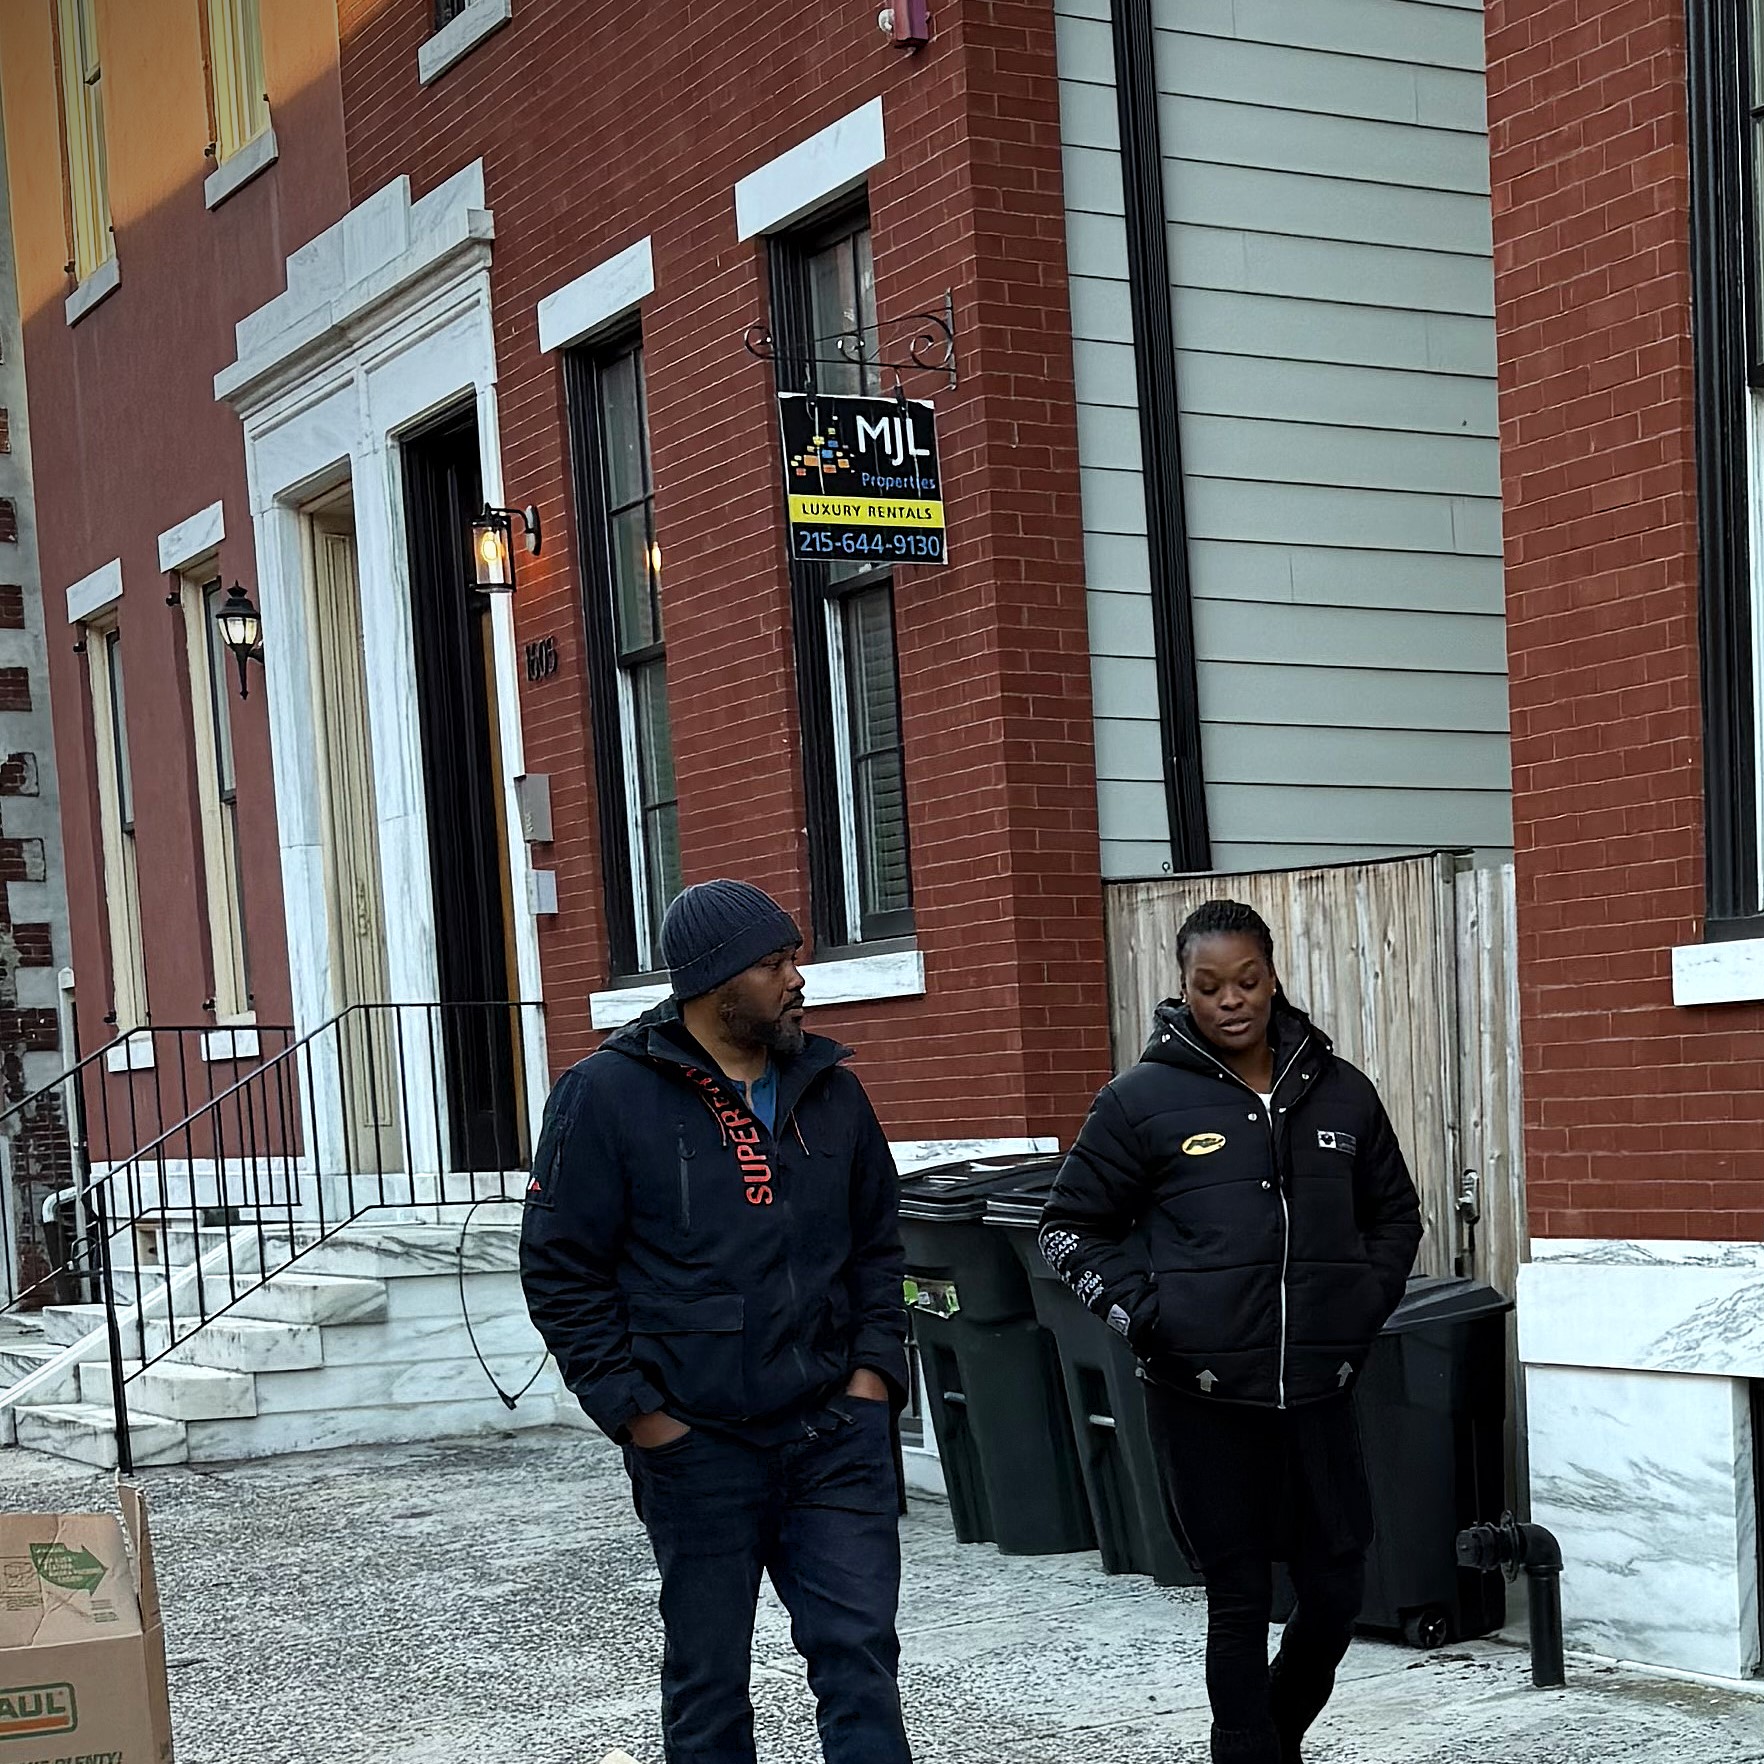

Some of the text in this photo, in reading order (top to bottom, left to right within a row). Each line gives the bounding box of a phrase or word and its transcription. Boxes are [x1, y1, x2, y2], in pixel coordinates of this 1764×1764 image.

[856, 415, 930, 466] MJL
[802, 503, 932, 520] LUXURY RENTALS
[800, 530, 940, 557] 215-644-9130
